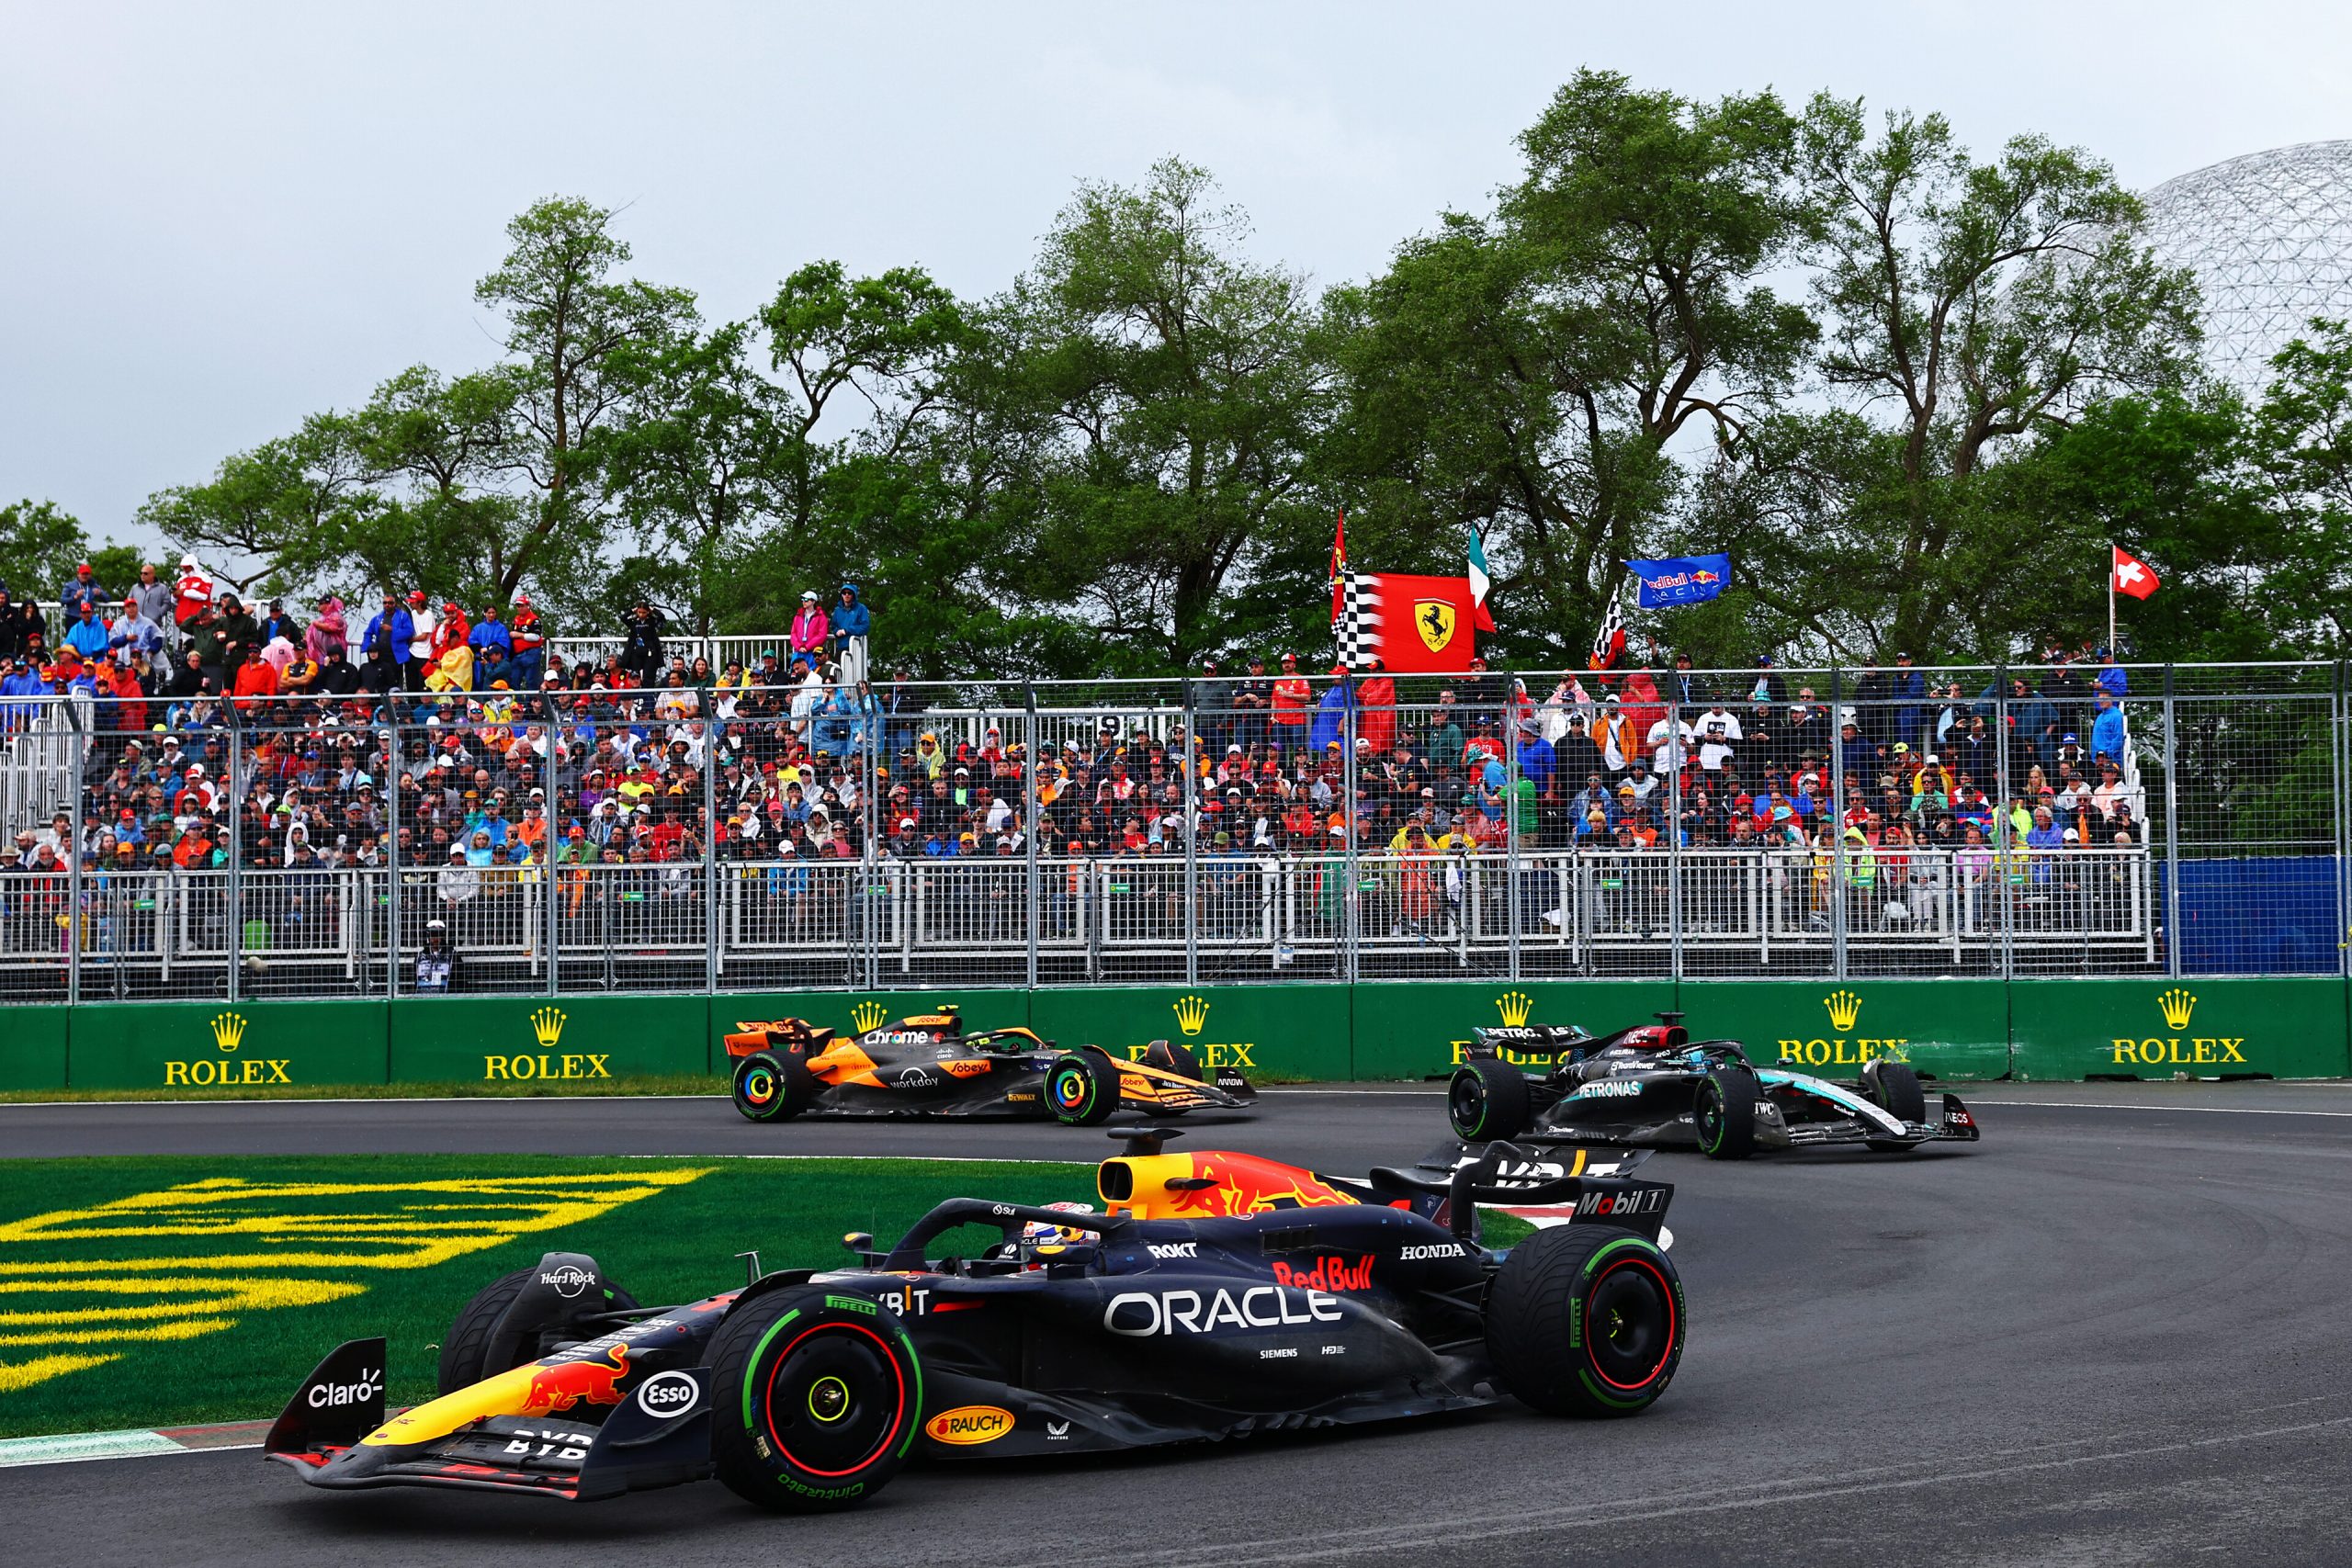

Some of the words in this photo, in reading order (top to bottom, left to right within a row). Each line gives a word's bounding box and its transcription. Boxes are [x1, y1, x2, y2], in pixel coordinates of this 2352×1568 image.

[1643, 576, 1665, 589] ed
[1664, 572, 1688, 588] Bull
[864, 1029, 928, 1044] Chrome
[1487, 1026, 1568, 1039] PETROAS
[1778, 1039, 1911, 1065] ROLEX
[2111, 1038, 2247, 1064] ROLEX
[164, 1059, 292, 1085] ROLEX
[484, 1054, 612, 1079] ROLEX
[951, 1060, 989, 1073] Sobeys
[889, 1077, 938, 1089] workday
[1121, 1077, 1145, 1087] Sobeys
[1578, 1080, 1641, 1098] PETRONAS
[1755, 1102, 1774, 1115] IWC
[1945, 1112, 1968, 1124] INEOS
[1576, 1190, 1643, 1215] Mobil
[1148, 1243, 1198, 1259] ROKT
[1400, 1244, 1466, 1260] HONDA
[540, 1272, 568, 1285] Hard
[569, 1271, 595, 1286] Rock
[1272, 1257, 1327, 1292] Red
[1328, 1255, 1375, 1292] Bull
[825, 1294, 877, 1316] PIRELLI
[1103, 1286, 1343, 1337] ORACLE
[1569, 1296, 1581, 1348] PIRELLI
[1260, 1348, 1298, 1359] SIEMENS
[309, 1381, 372, 1410] Claro
[648, 1383, 689, 1405] Esso
[950, 1415, 1004, 1435] RAUCH
[777, 1472, 865, 1501] Cinturato
